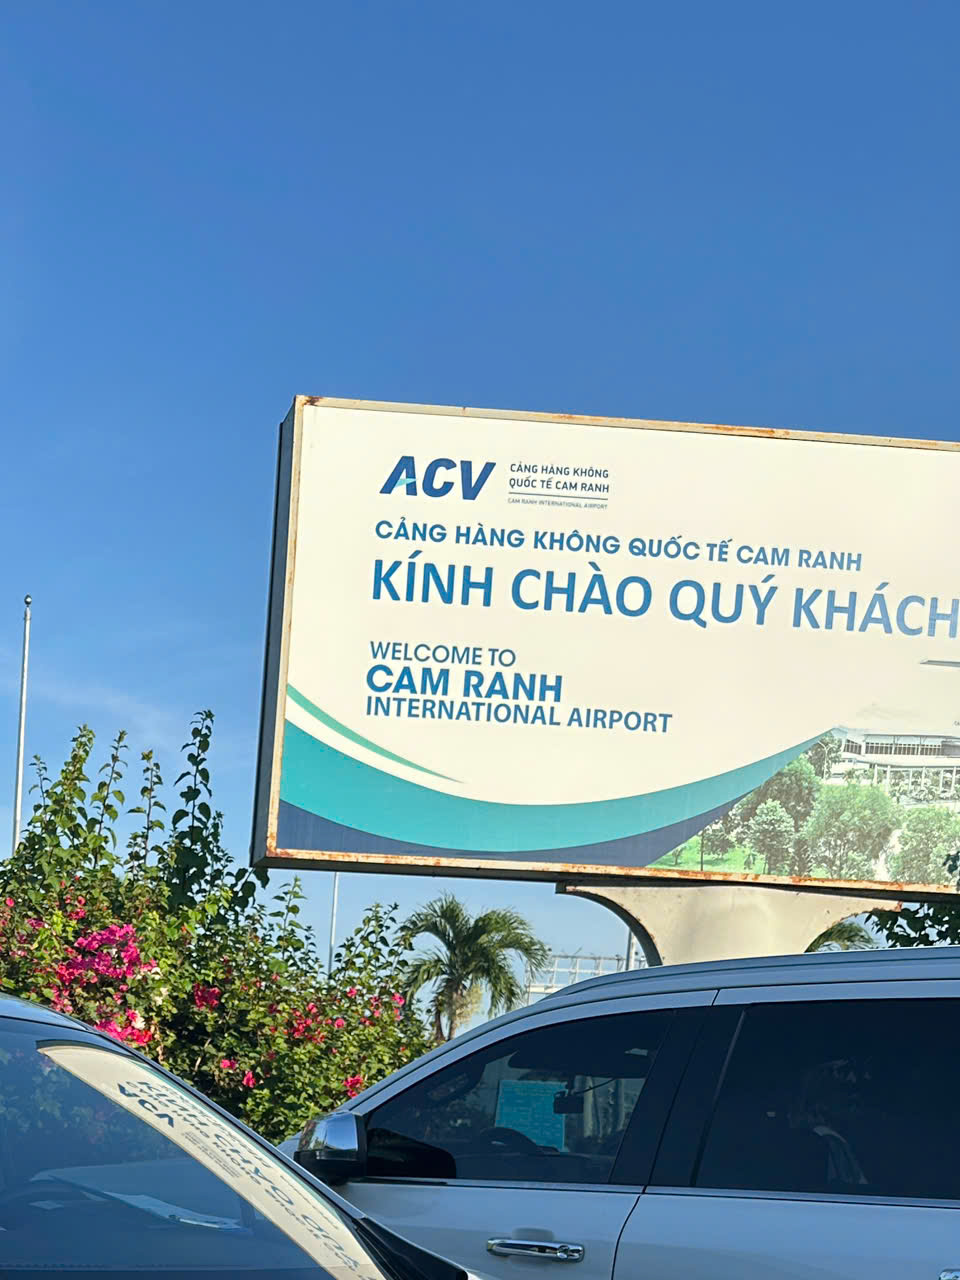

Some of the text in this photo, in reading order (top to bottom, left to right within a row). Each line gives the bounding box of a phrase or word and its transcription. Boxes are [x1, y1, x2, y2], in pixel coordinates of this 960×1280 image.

[379, 455, 497, 501] ACV
[510, 461, 538, 474] CẢNG
[573, 466, 609, 479] KHÔNG
[555, 480, 578, 492] CAM
[580, 482, 609, 494] RANH
[375, 516, 862, 572] CẢNG HÀNG KHÔNG QUỐC TẾ CAM RANH
[372, 549, 960, 639] KÍNH CHÀO QUÝ KHÁCH
[369, 640, 517, 668] WELCOME TO
[365, 663, 563, 703] CAM RANH
[365, 695, 674, 734] INTERNATIONAL AIRPORT
